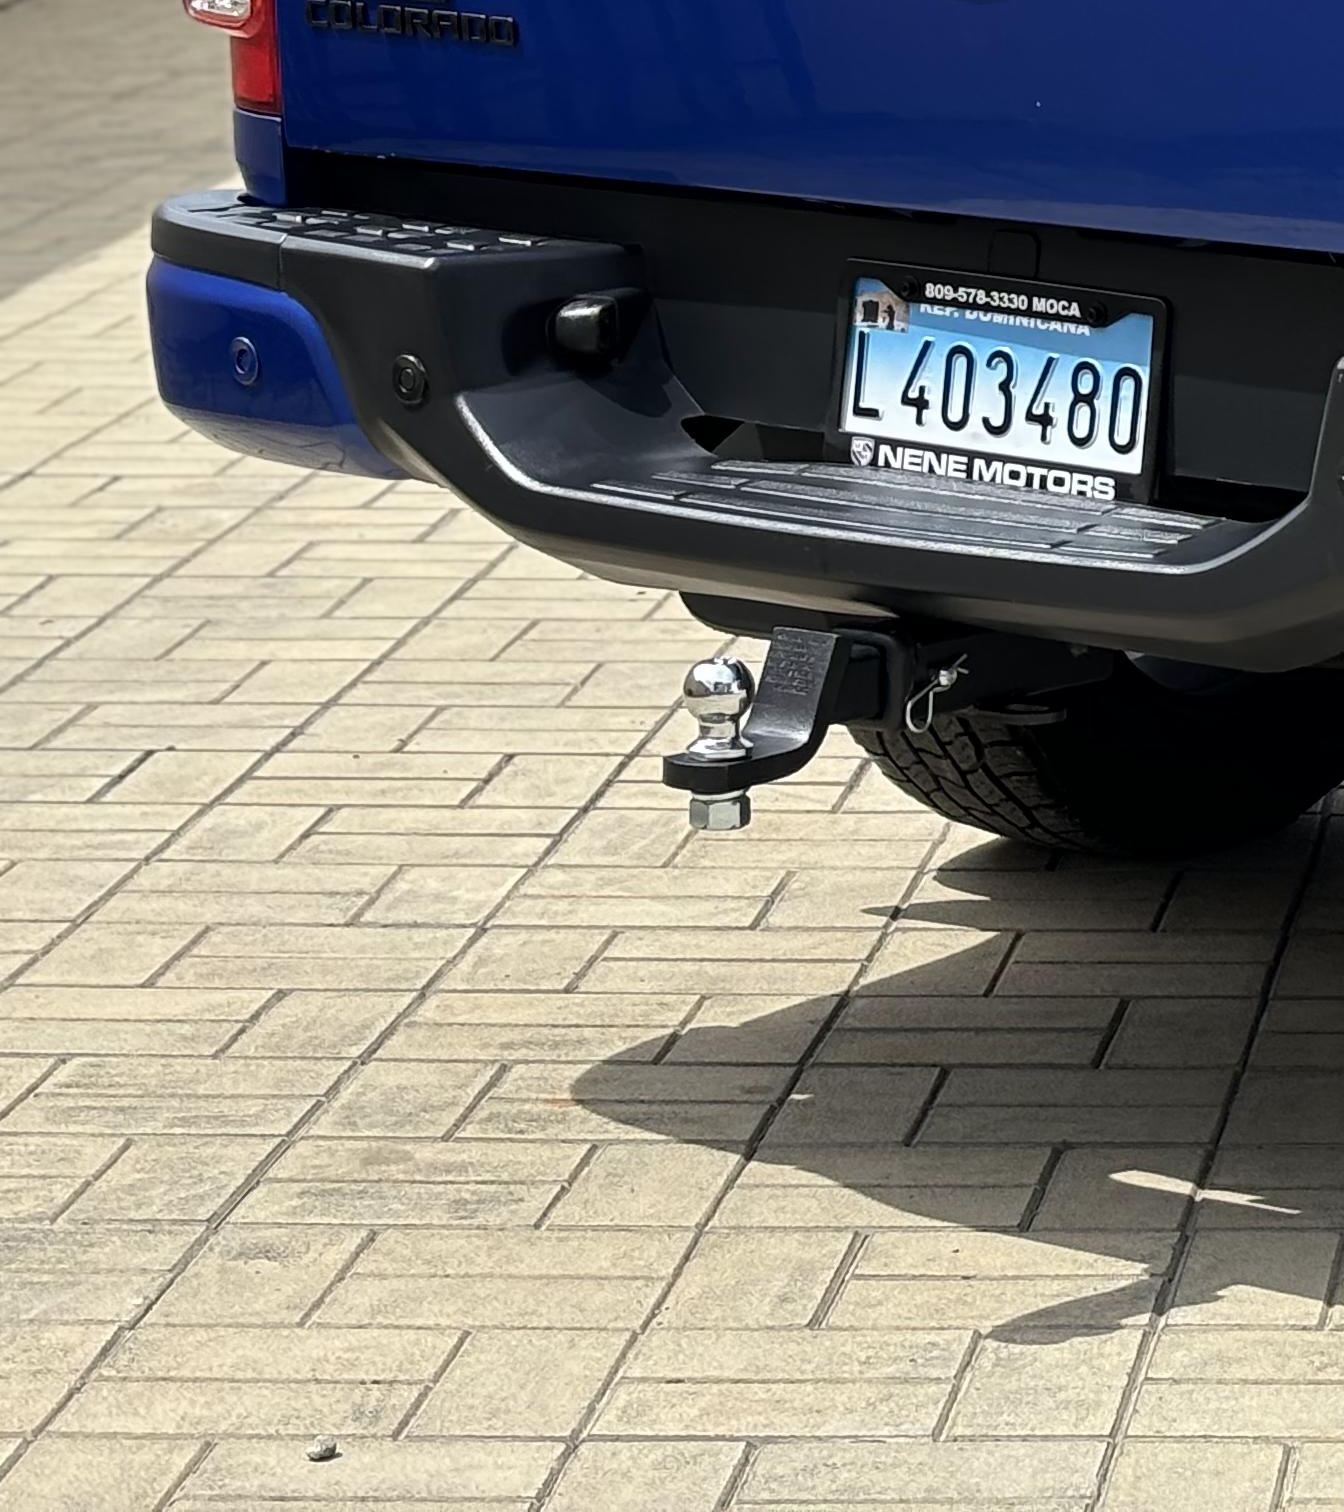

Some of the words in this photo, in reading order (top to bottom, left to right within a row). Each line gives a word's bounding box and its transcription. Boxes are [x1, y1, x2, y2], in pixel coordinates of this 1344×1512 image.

[925, 282, 1028, 311] 809-578-3330
[1032, 297, 1081, 318] MOCA
[878, 444, 968, 479] NENE
[973, 458, 1116, 501] MOTORS
